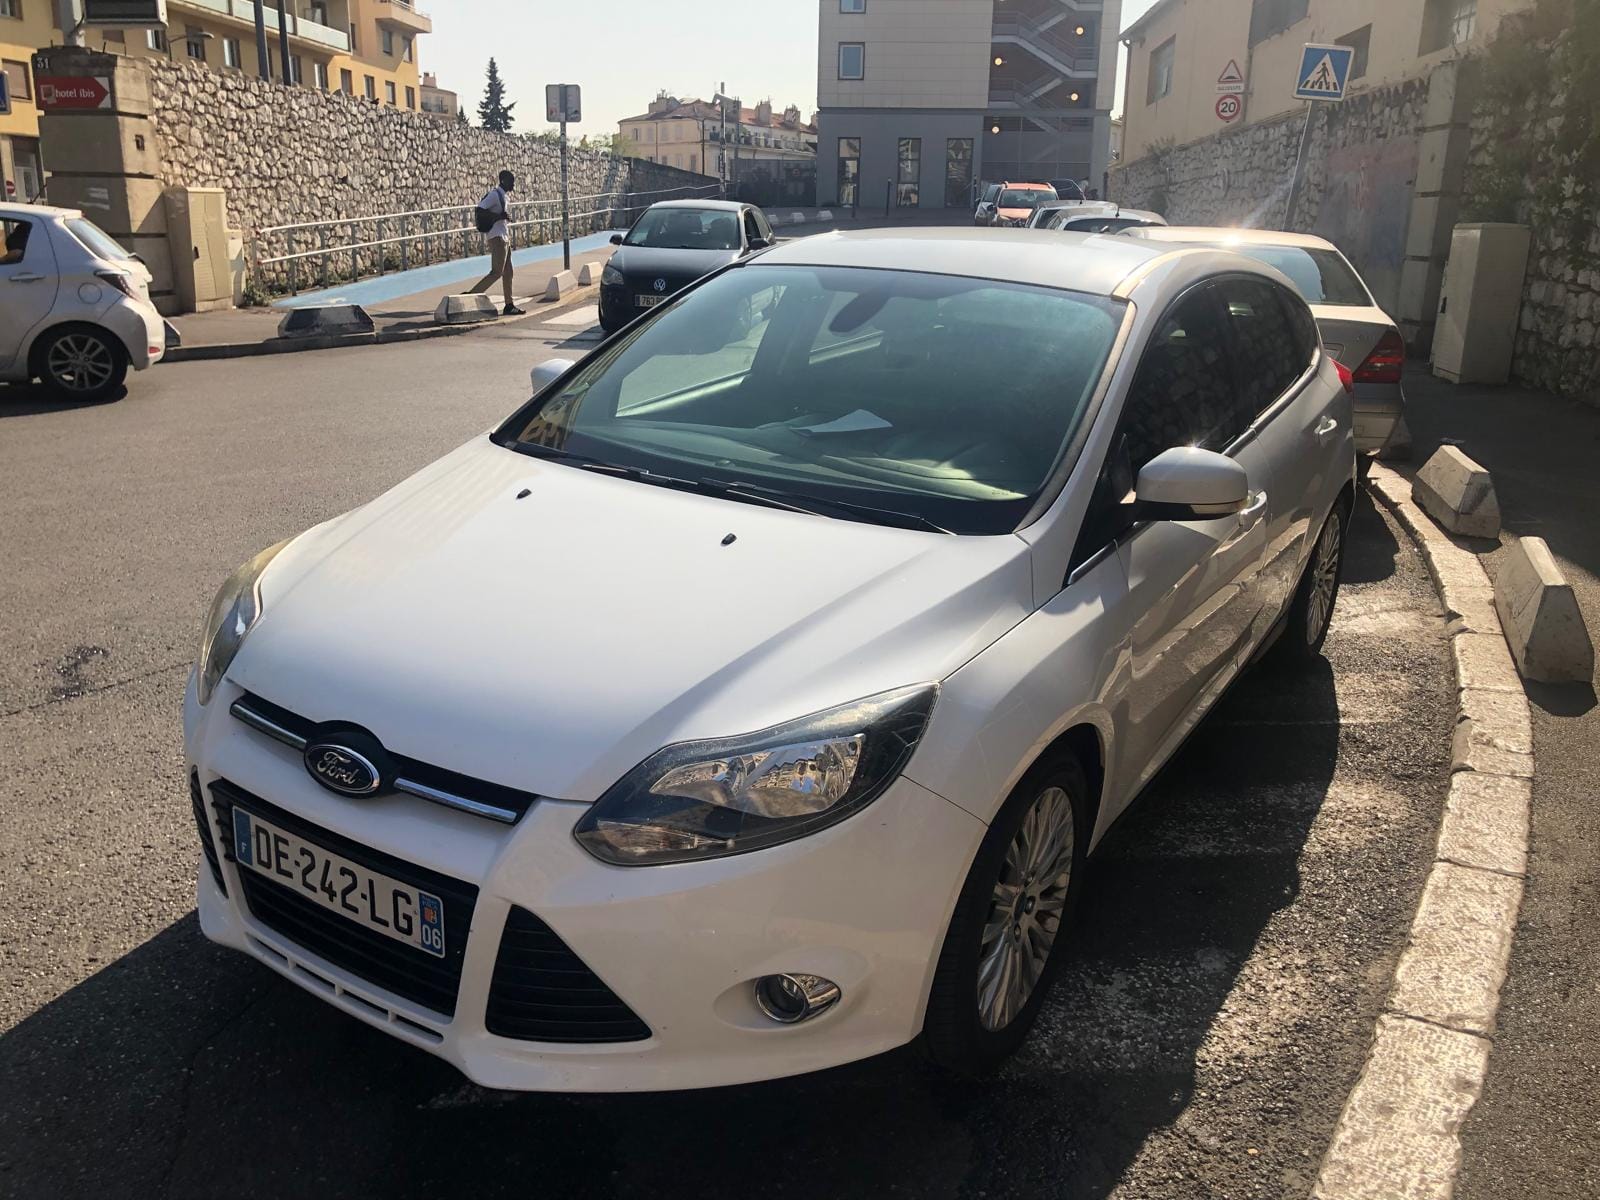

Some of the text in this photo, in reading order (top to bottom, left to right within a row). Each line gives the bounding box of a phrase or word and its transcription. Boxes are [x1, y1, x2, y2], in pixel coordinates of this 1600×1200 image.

[55, 88, 95, 98] hotel ibis
[1220, 101, 1236, 113] 20
[316, 751, 361, 785] Ford
[254, 824, 413, 937] DE-242-LG
[422, 924, 442, 950] 06
